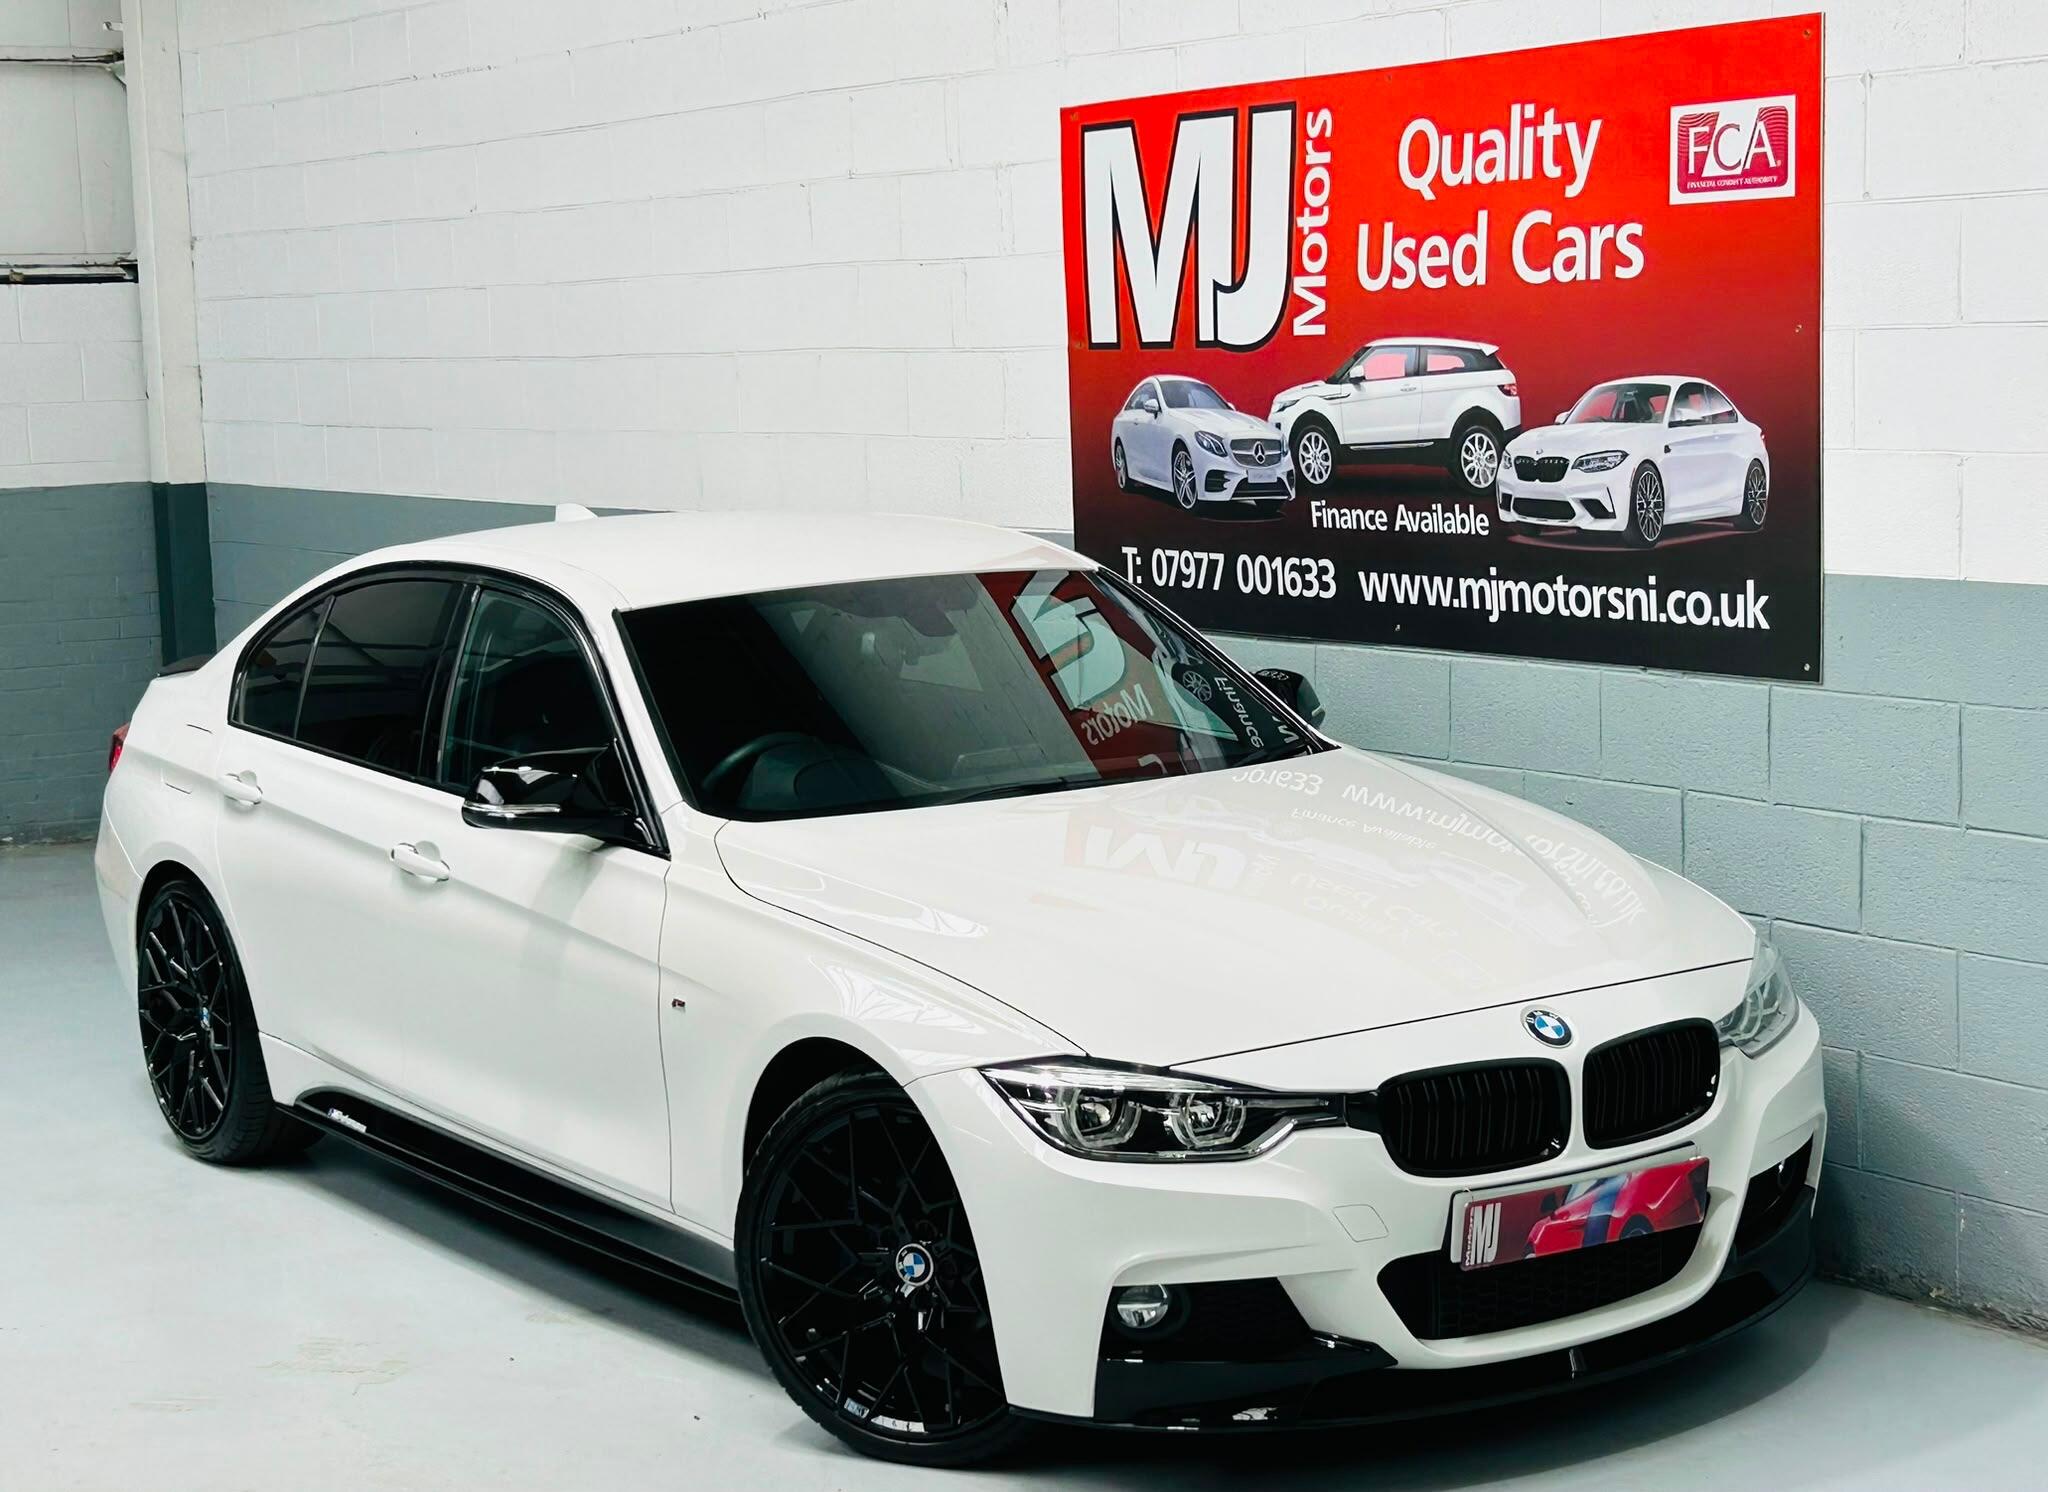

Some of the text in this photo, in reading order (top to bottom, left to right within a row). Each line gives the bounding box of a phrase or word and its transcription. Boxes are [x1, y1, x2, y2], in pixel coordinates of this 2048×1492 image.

[1399, 103, 1602, 201] Quality
[1687, 120, 1778, 174] FCA
[1081, 102, 1296, 351] MJ
[1292, 107, 1333, 337] Motors
[1357, 209, 1645, 293] Used Cars
[1310, 501, 1490, 537] Finance Available
[1122, 546, 1336, 599] T: 07977 001633
[1358, 565, 1770, 630] www.mjmotorsni.co.uk
[1470, 1202, 1501, 1265] MJ
